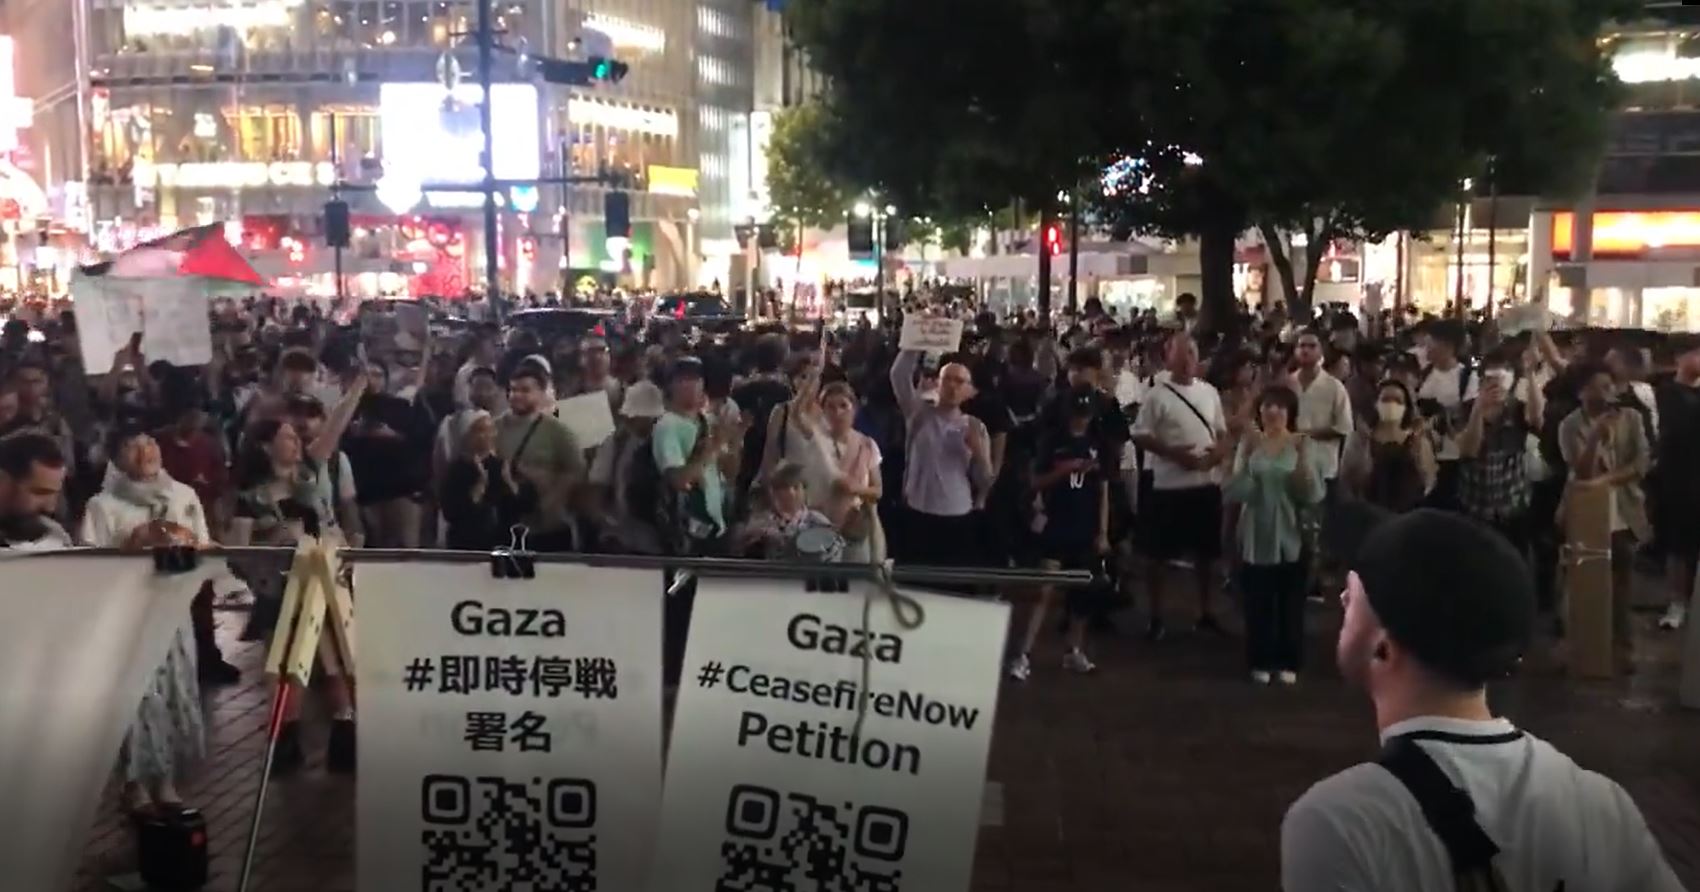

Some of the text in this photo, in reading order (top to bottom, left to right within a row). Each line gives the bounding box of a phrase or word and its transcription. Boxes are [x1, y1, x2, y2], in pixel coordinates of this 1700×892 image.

[451, 600, 566, 637] Gaza
[787, 613, 903, 663] Gaza
[403, 655, 618, 699] #即時停戦
[464, 711, 552, 753] 署名
[737, 711, 921, 776] Petition
